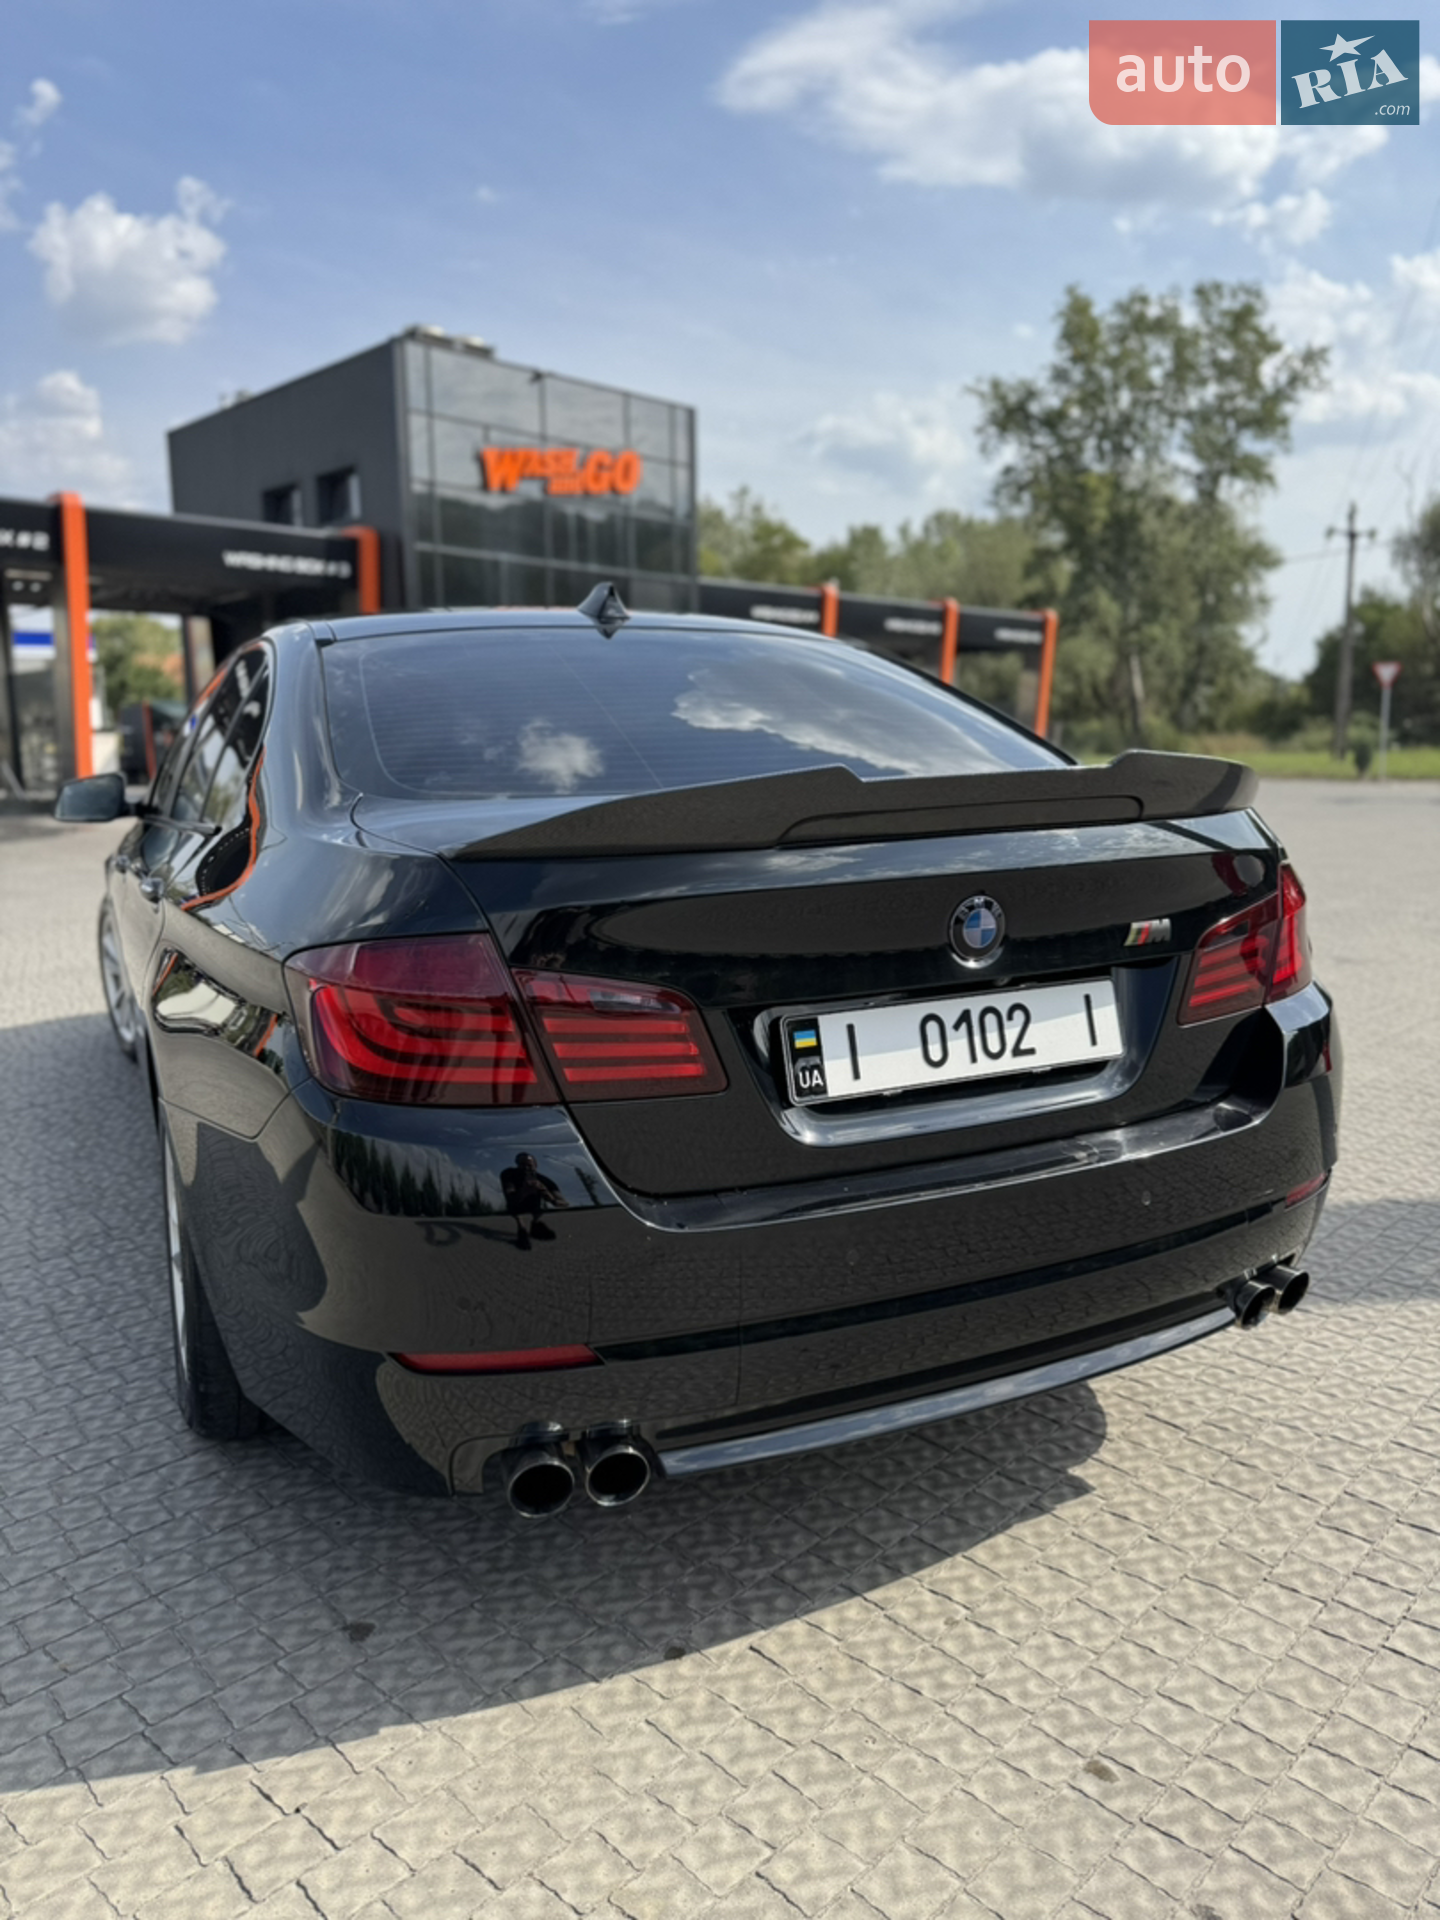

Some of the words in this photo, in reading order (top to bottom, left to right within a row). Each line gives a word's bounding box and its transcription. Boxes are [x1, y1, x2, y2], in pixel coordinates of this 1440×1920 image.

[583, 448, 643, 496] GO
[919, 1002, 1037, 1069] 0102
[799, 1069, 824, 1089] UA
